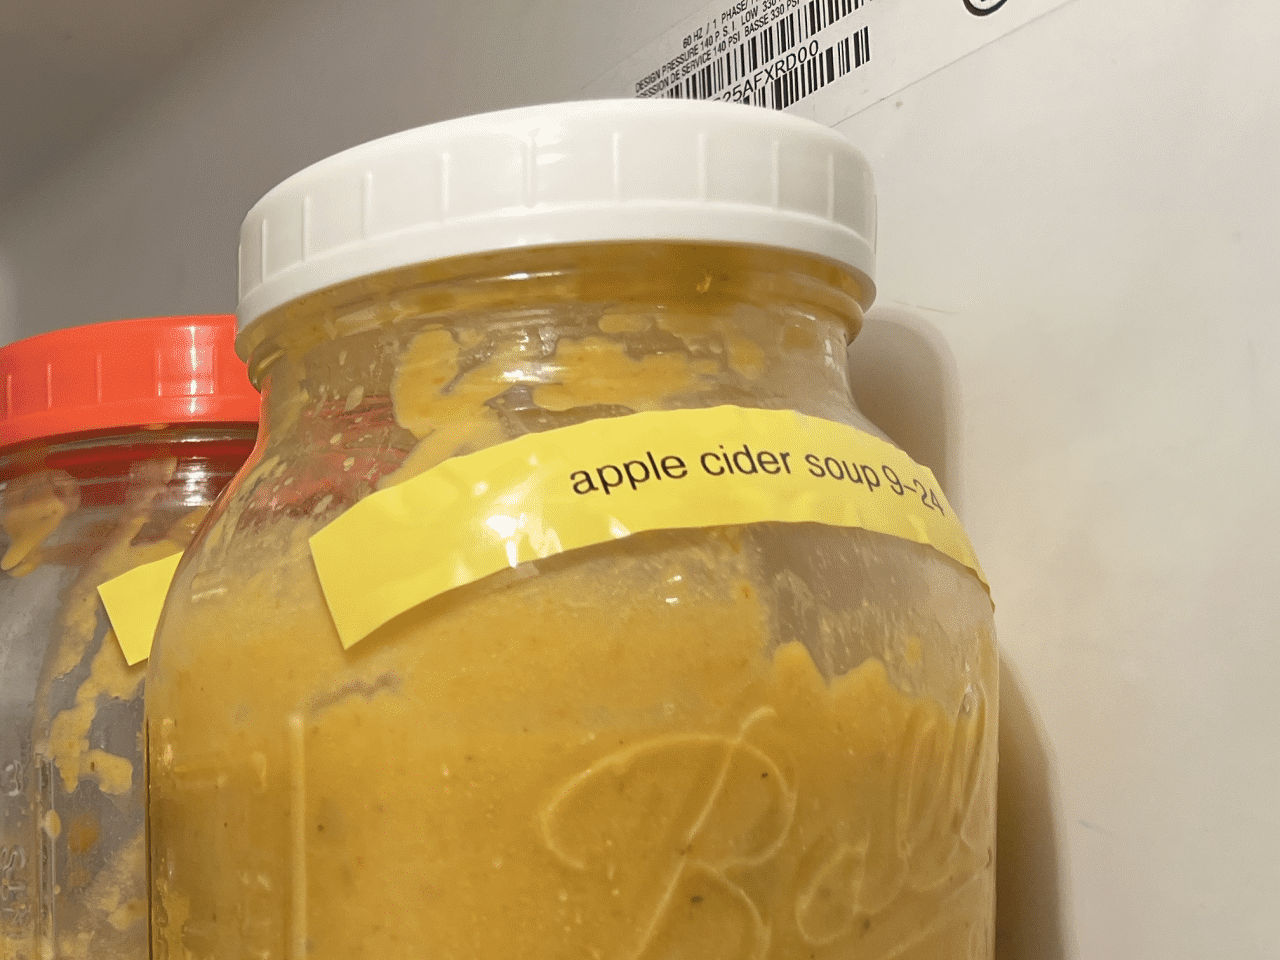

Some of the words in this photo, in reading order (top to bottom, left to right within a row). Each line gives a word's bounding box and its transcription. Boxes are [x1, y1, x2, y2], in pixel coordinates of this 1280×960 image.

[635, 69, 661, 94] DESIGN
[662, 44, 699, 77] PRESSURE
[701, 35, 714, 51] 140
[741, 5, 759, 26] LOW
[670, 69, 681, 84] DE
[682, 49, 712, 76] SERVICE
[713, 39, 727, 57] 140
[729, 30, 740, 48] PSI
[745, 13, 769, 38] BASSE
[771, 3, 785, 21] 330
[683, 35, 692, 49] 60
[693, 27, 703, 43] HZ
[570, 449, 689, 497] apple
[701, 444, 795, 479] cider
[803, 451, 881, 492] soup
